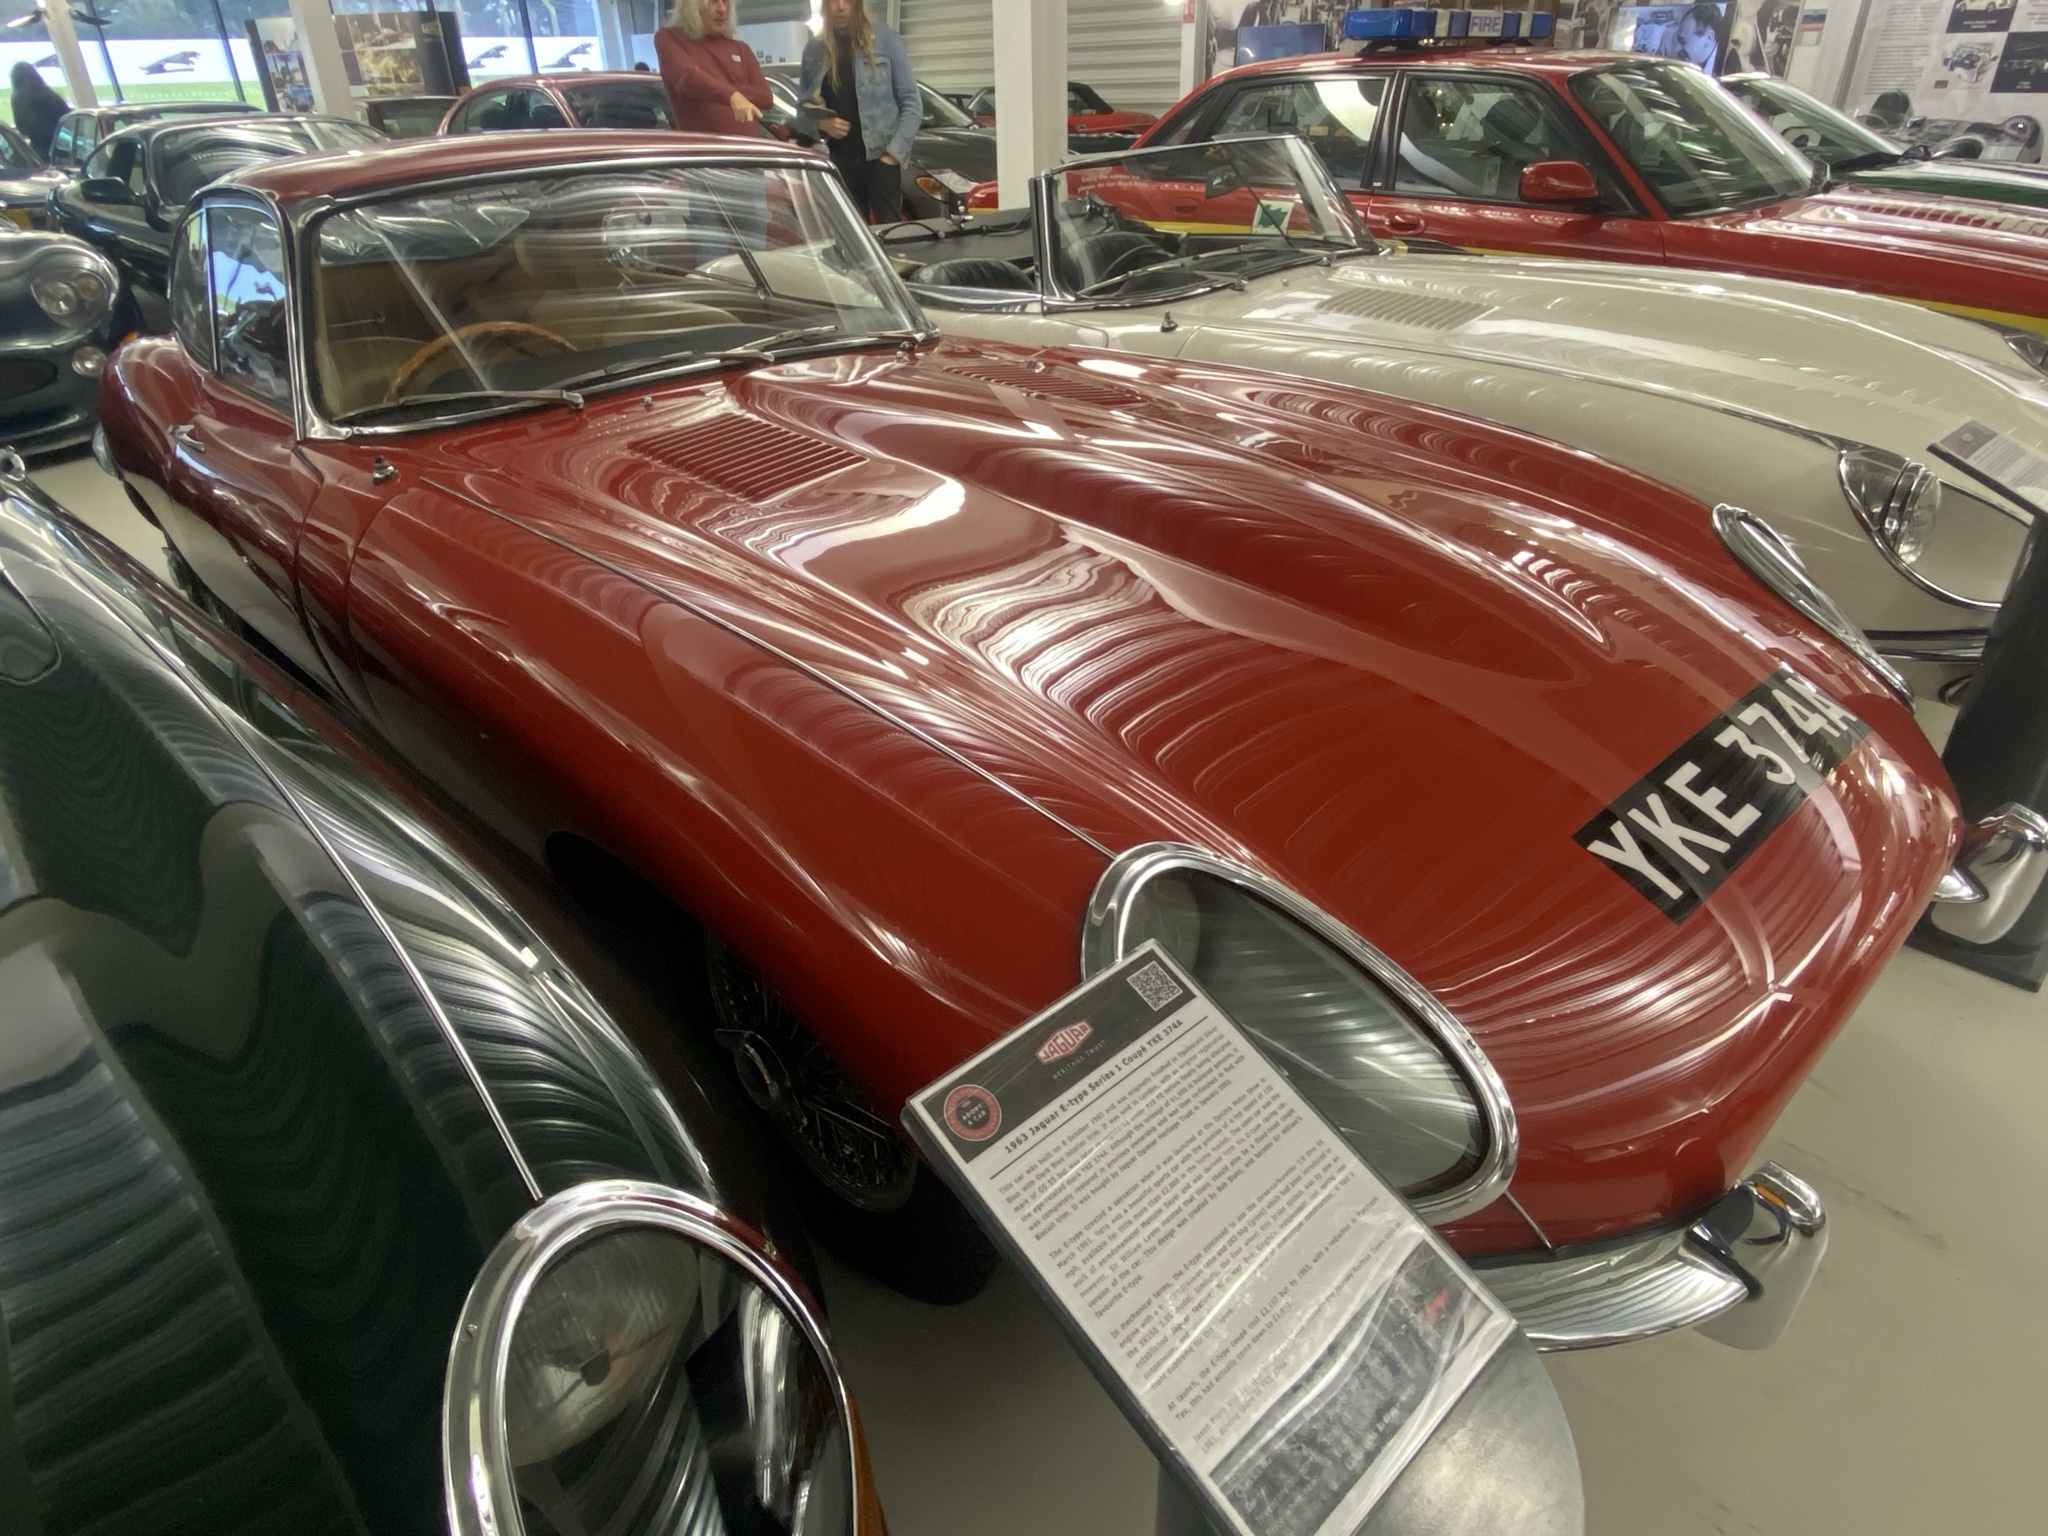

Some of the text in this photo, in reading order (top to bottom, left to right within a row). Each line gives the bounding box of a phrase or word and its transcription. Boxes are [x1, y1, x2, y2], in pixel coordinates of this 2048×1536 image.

[1471, 15, 1500, 33] FIRE
[1586, 676, 1859, 900] YKE 374A
[1041, 1023, 1091, 1061] JAGUAR
[1052, 1040, 1106, 1080] HERITAGE TRUST
[1003, 1018, 1183, 1154] 1963 Jaguar E-type Series 1 Coupé YKE 374A
[961, 1103, 983, 1121] ADOPT
[973, 1110, 987, 1121] CAR
[997, 1180, 1014, 1195] This
[1061, 1228, 1085, 1250] E-type
[1082, 1209, 1107, 1231] created
[1118, 1296, 1154, 1330] mechanical
